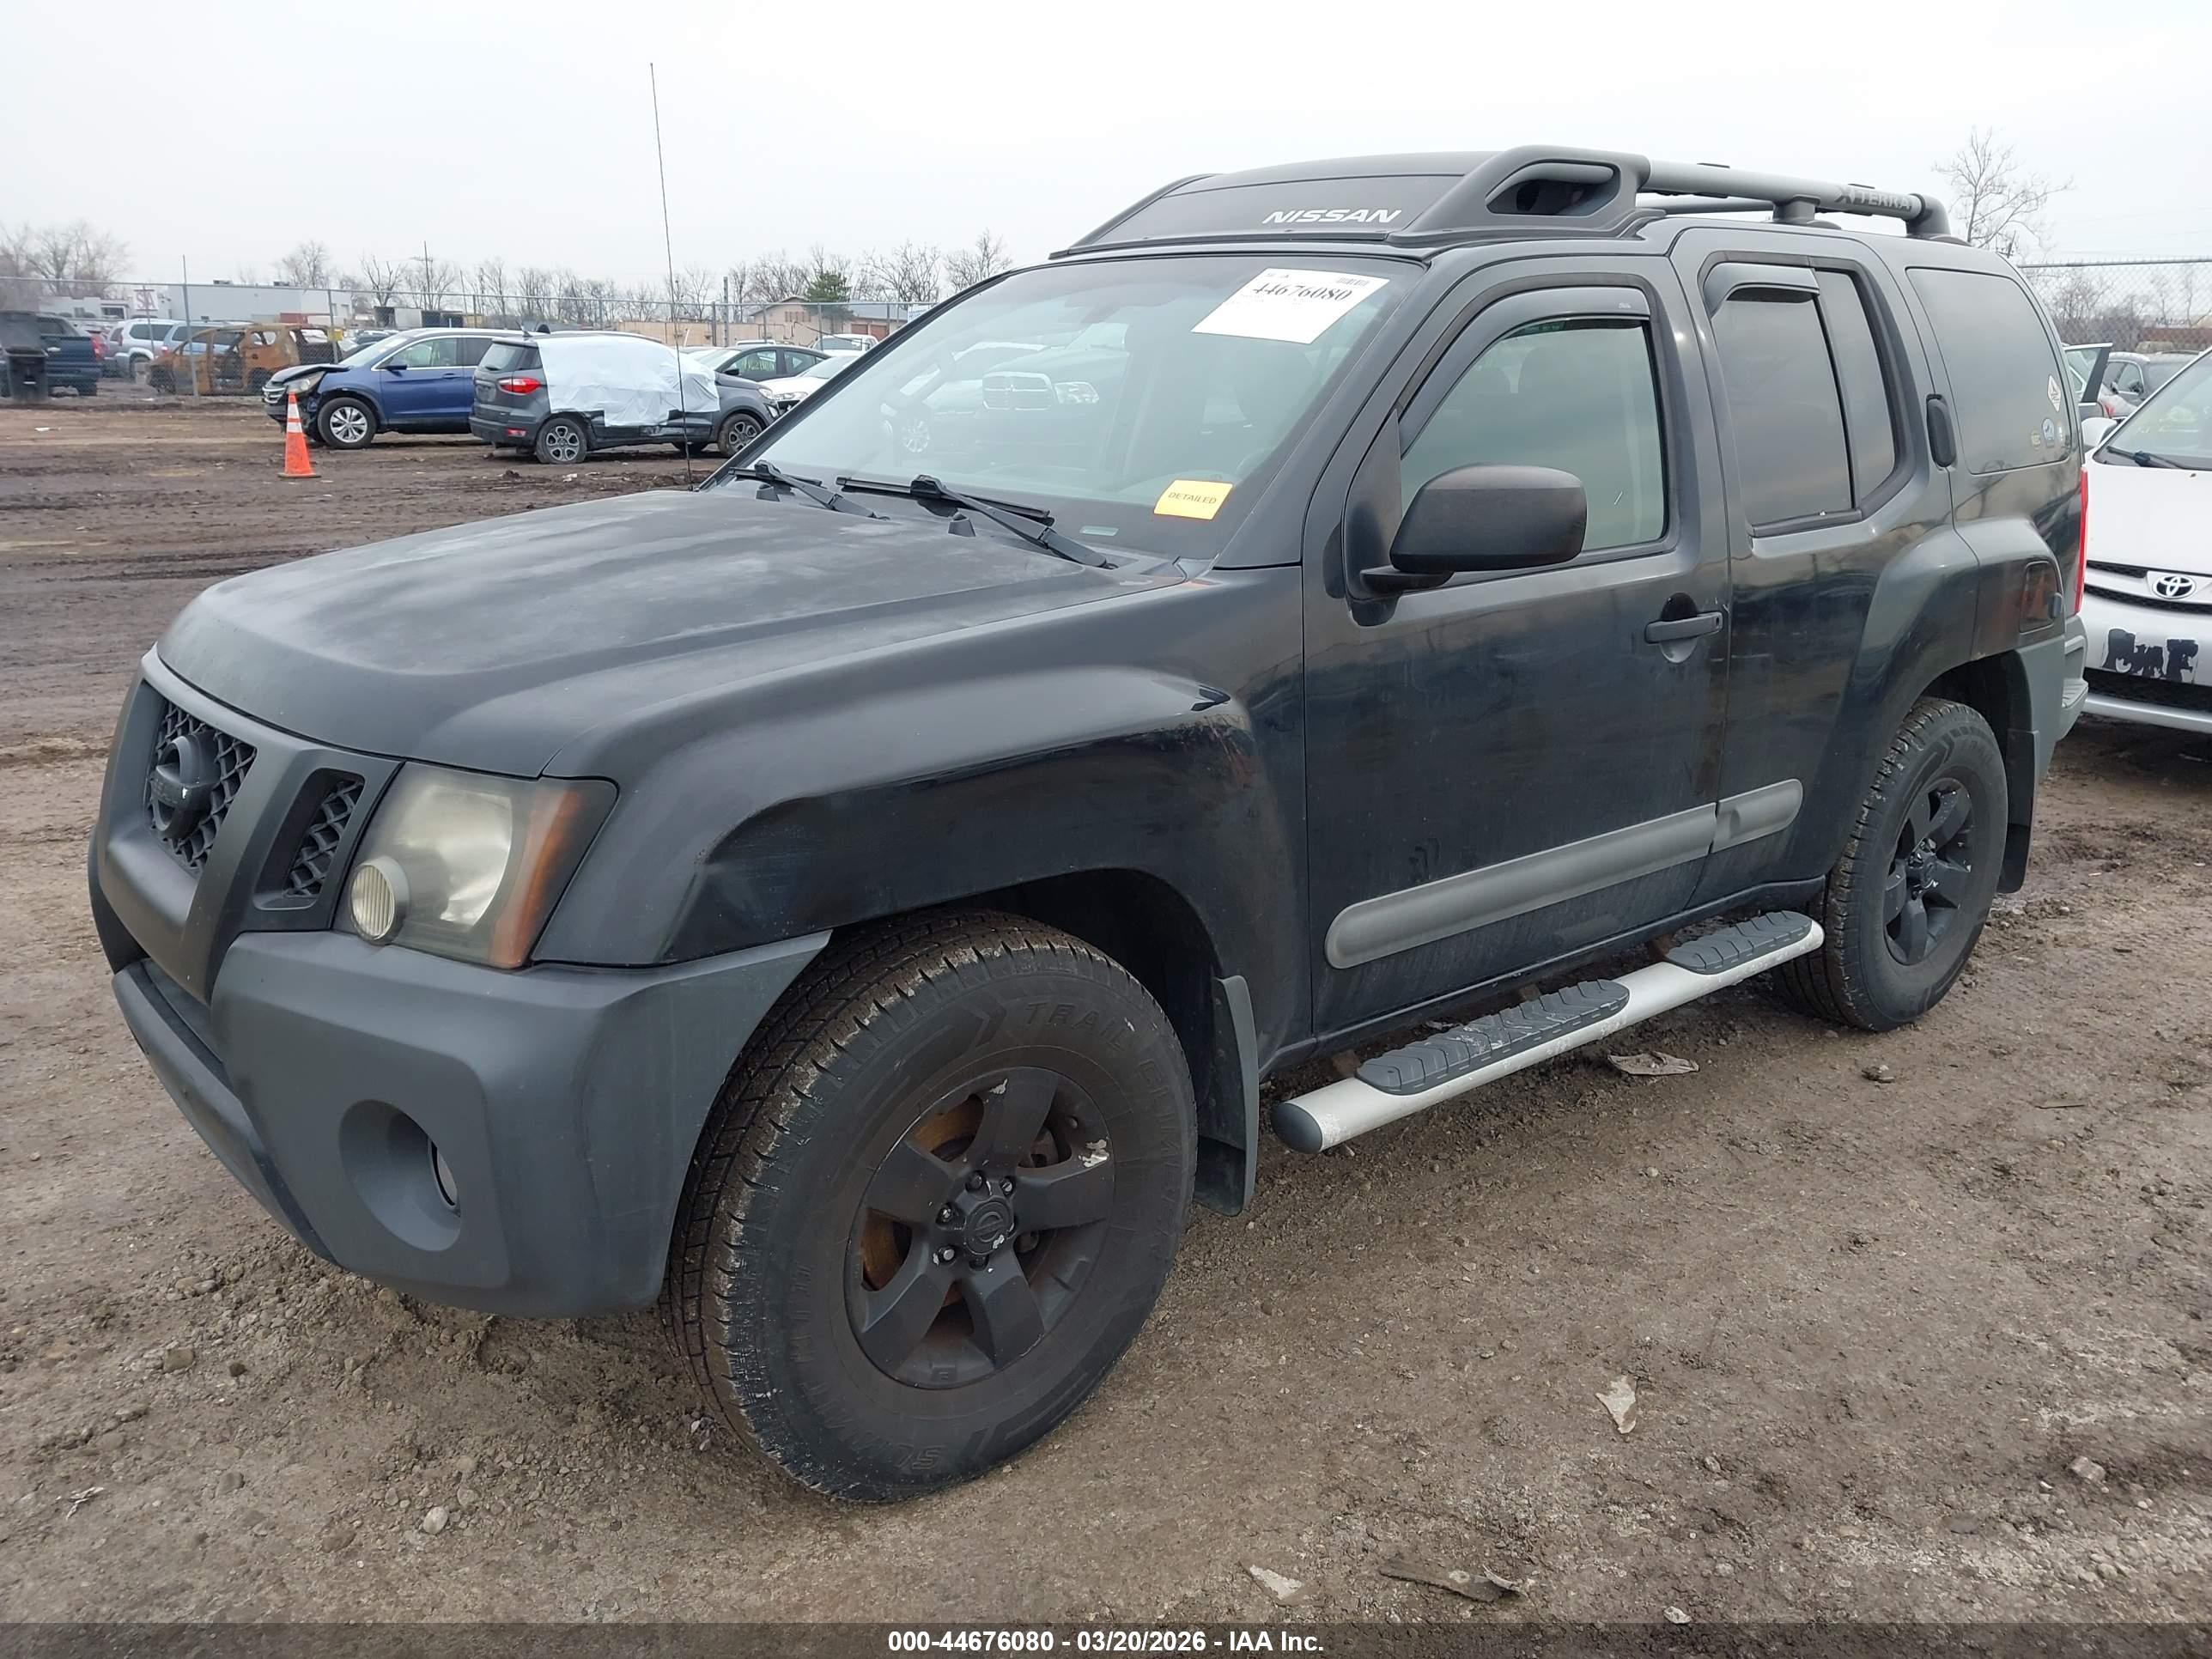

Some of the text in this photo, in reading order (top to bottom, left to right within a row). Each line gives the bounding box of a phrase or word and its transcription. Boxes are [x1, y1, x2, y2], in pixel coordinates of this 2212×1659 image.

[1834, 185, 1913, 210] XTERRA
[1262, 209, 1401, 223] NISSAN
[1253, 282, 1352, 301] 44676080
[1168, 492, 1217, 504] DETAILED
[1024, 1001, 1129, 1053] TRAIL
